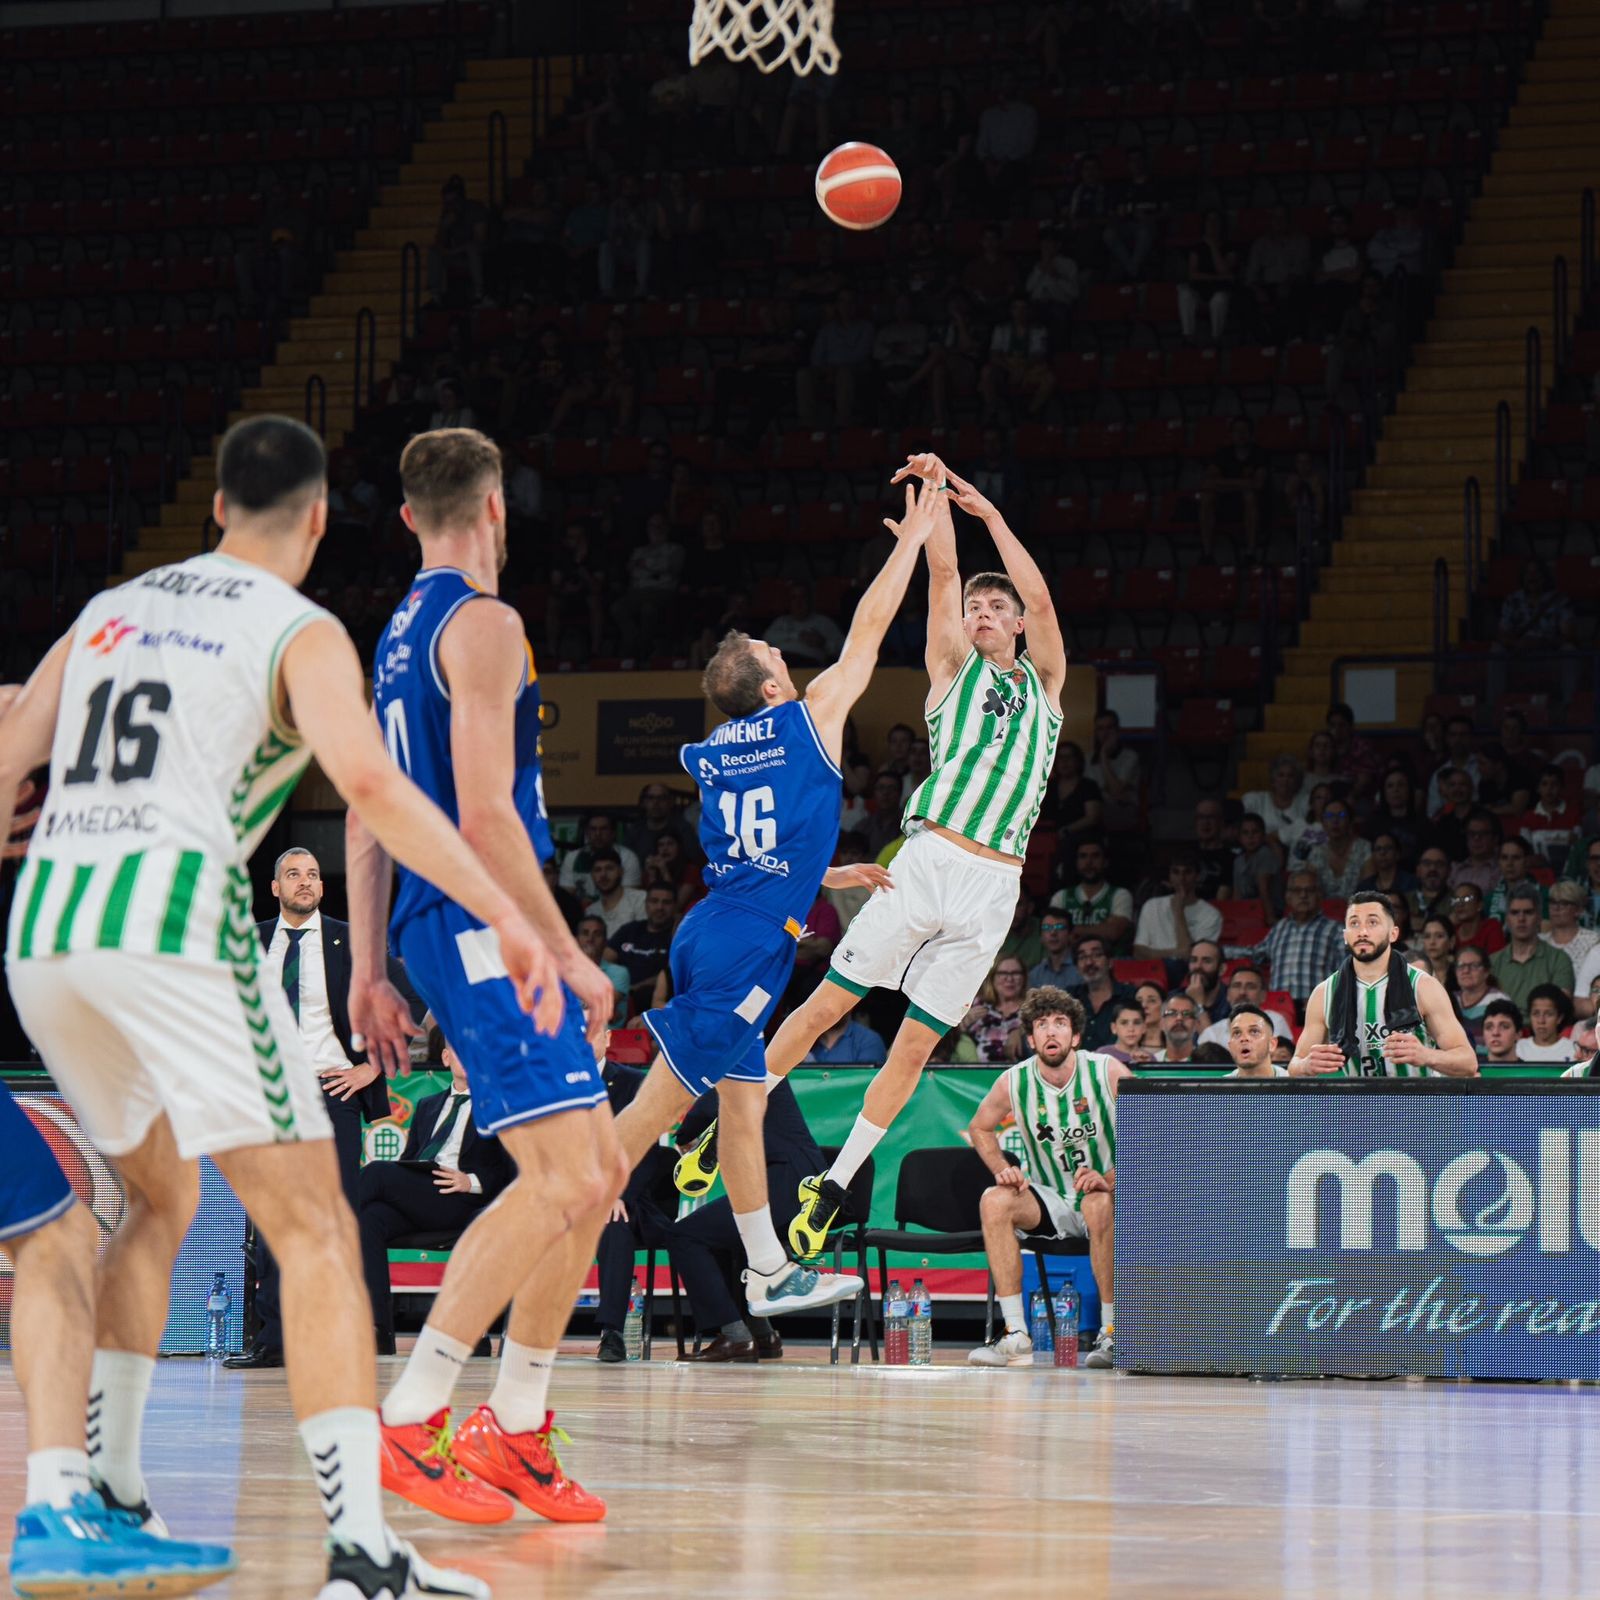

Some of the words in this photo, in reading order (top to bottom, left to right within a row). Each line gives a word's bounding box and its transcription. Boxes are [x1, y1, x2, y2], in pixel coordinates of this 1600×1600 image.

[64, 677, 172, 785] 16
[709, 717, 776, 747] JIMÉNEZ
[720, 746, 785, 767] Recoletas
[722, 768, 738, 777] RED
[56, 802, 157, 835] MEDAC
[719, 785, 777, 858] 16
[1361, 1055, 1388, 1077] 21
[1059, 1149, 1087, 1172] 12
[1266, 1277, 1370, 1336] For
[1377, 1276, 1486, 1333] the
